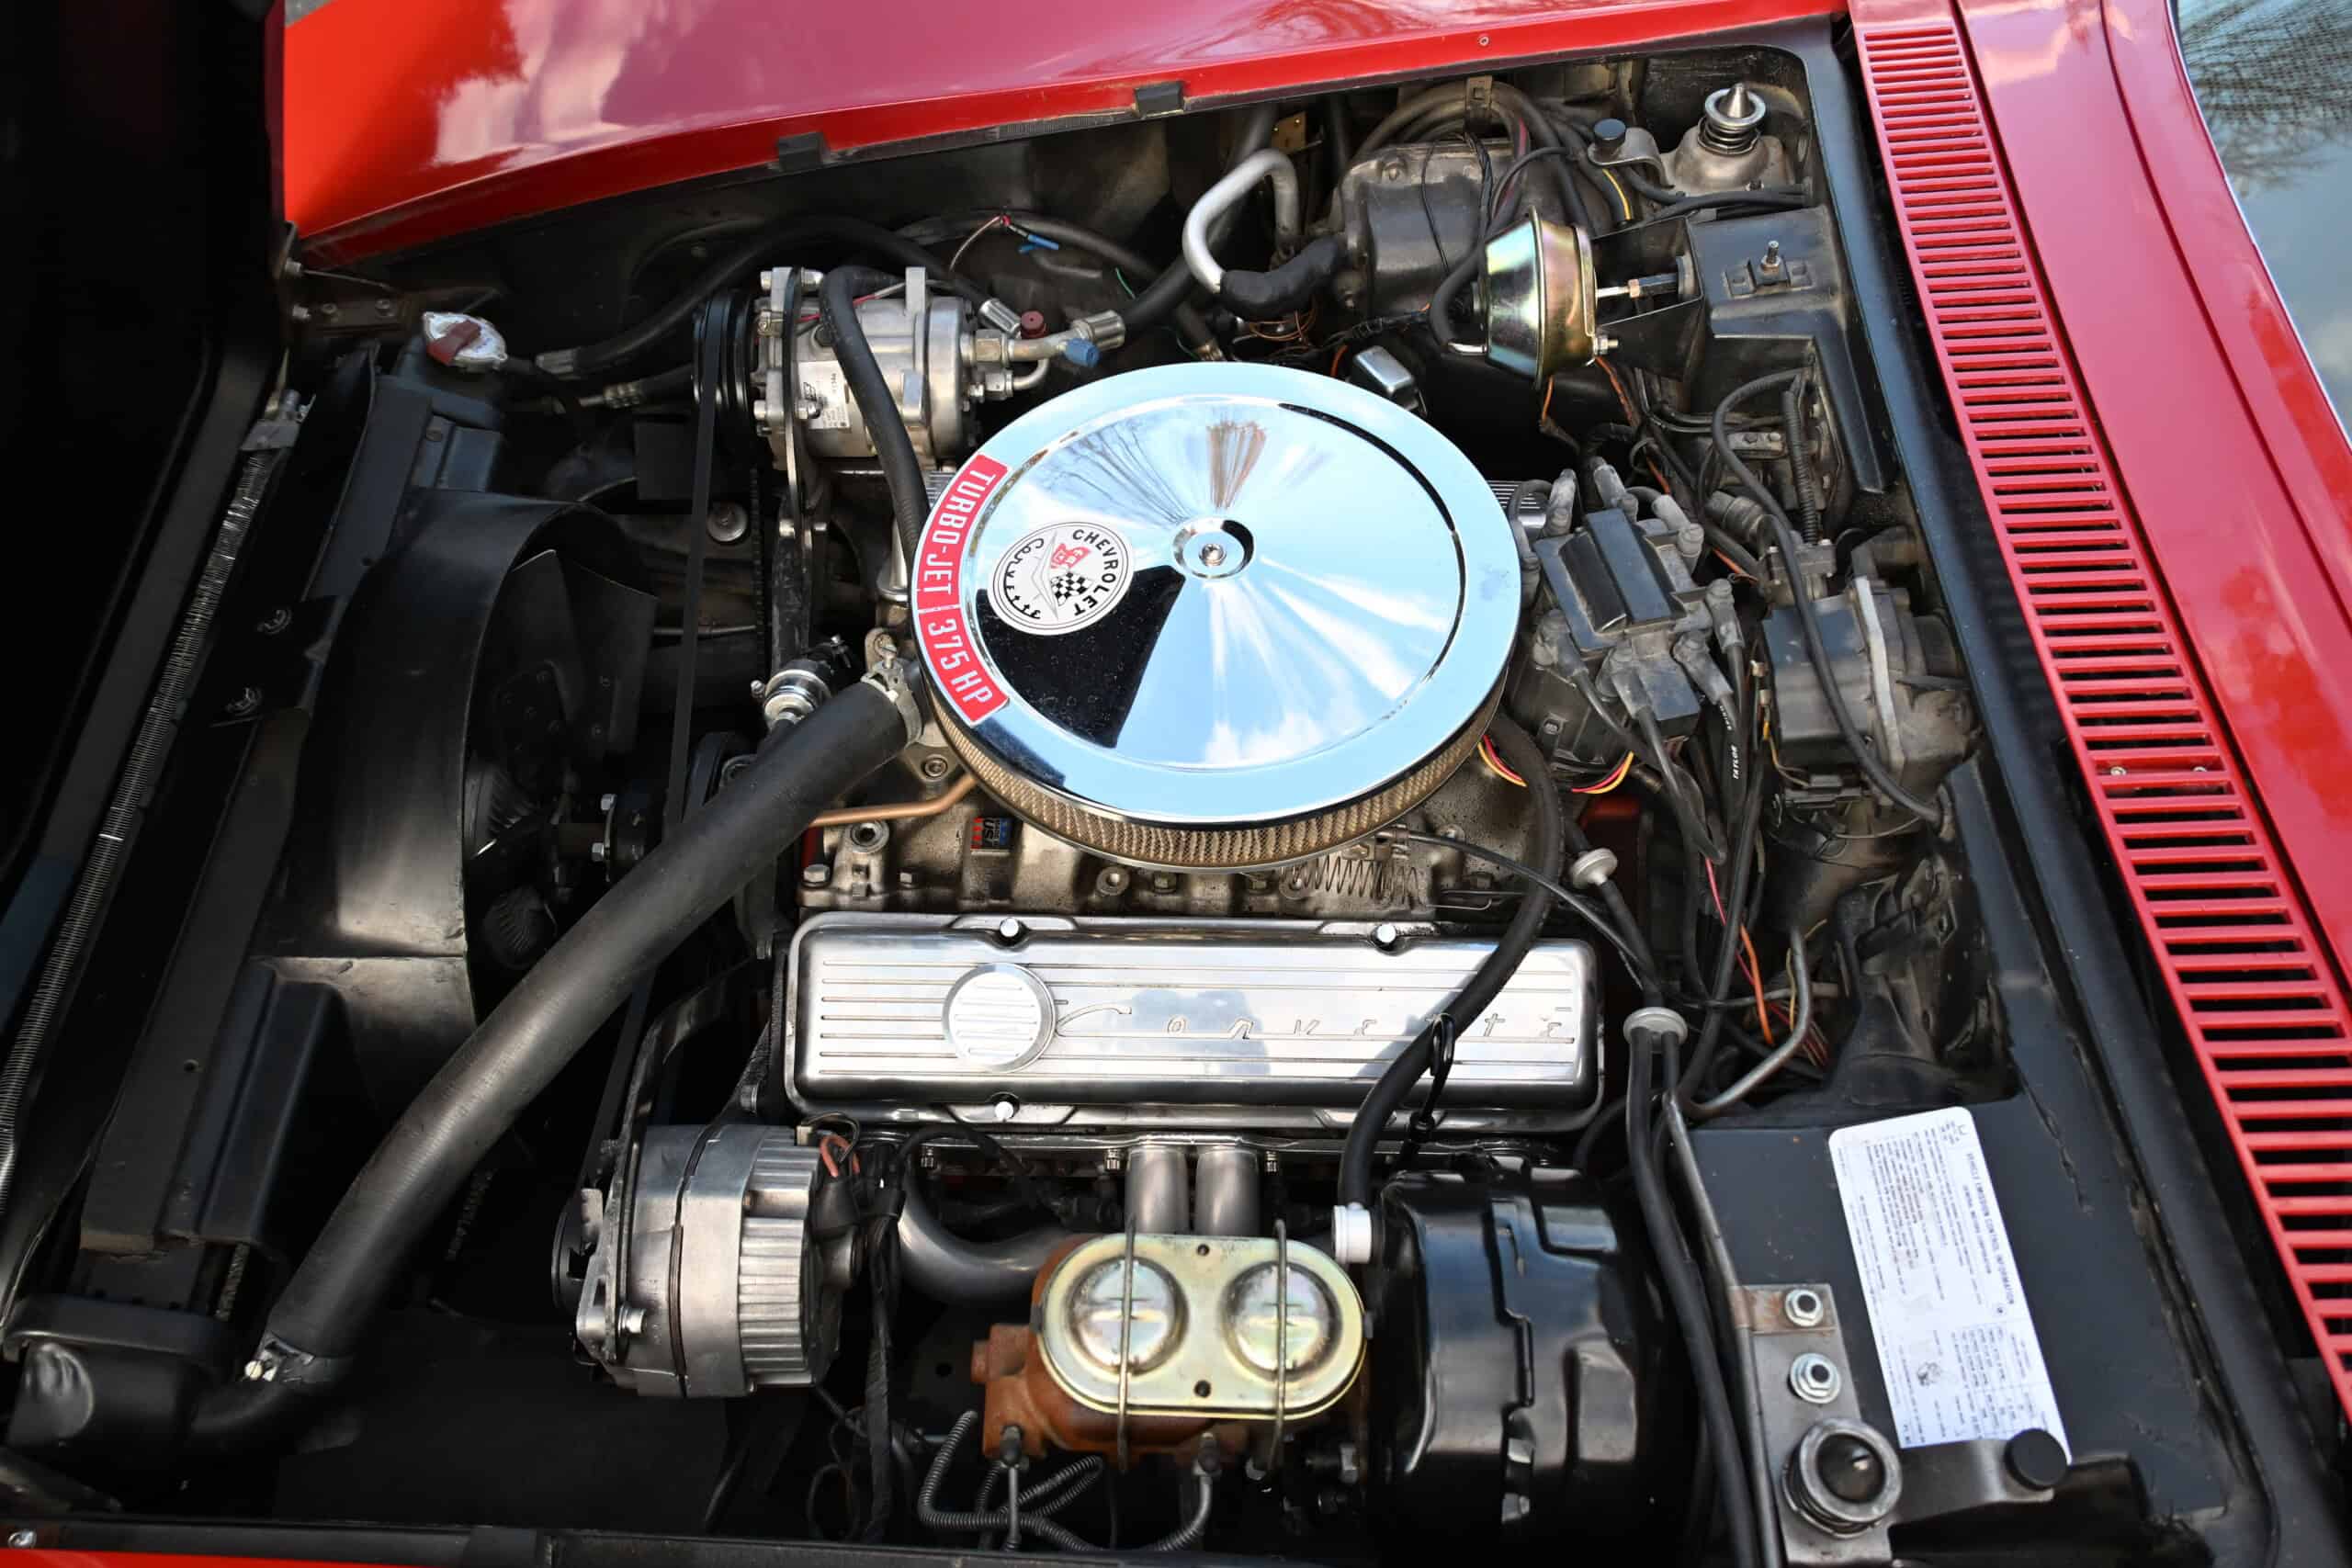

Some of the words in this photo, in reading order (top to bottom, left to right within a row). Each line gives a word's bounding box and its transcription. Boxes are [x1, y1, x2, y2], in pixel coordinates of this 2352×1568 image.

[922, 469, 996, 595] TURBO-JET
[1072, 528, 1119, 616] CHEVROLET
[1002, 537, 1045, 620] Corvette
[927, 618, 970, 671] 375
[950, 671, 993, 704] HP
